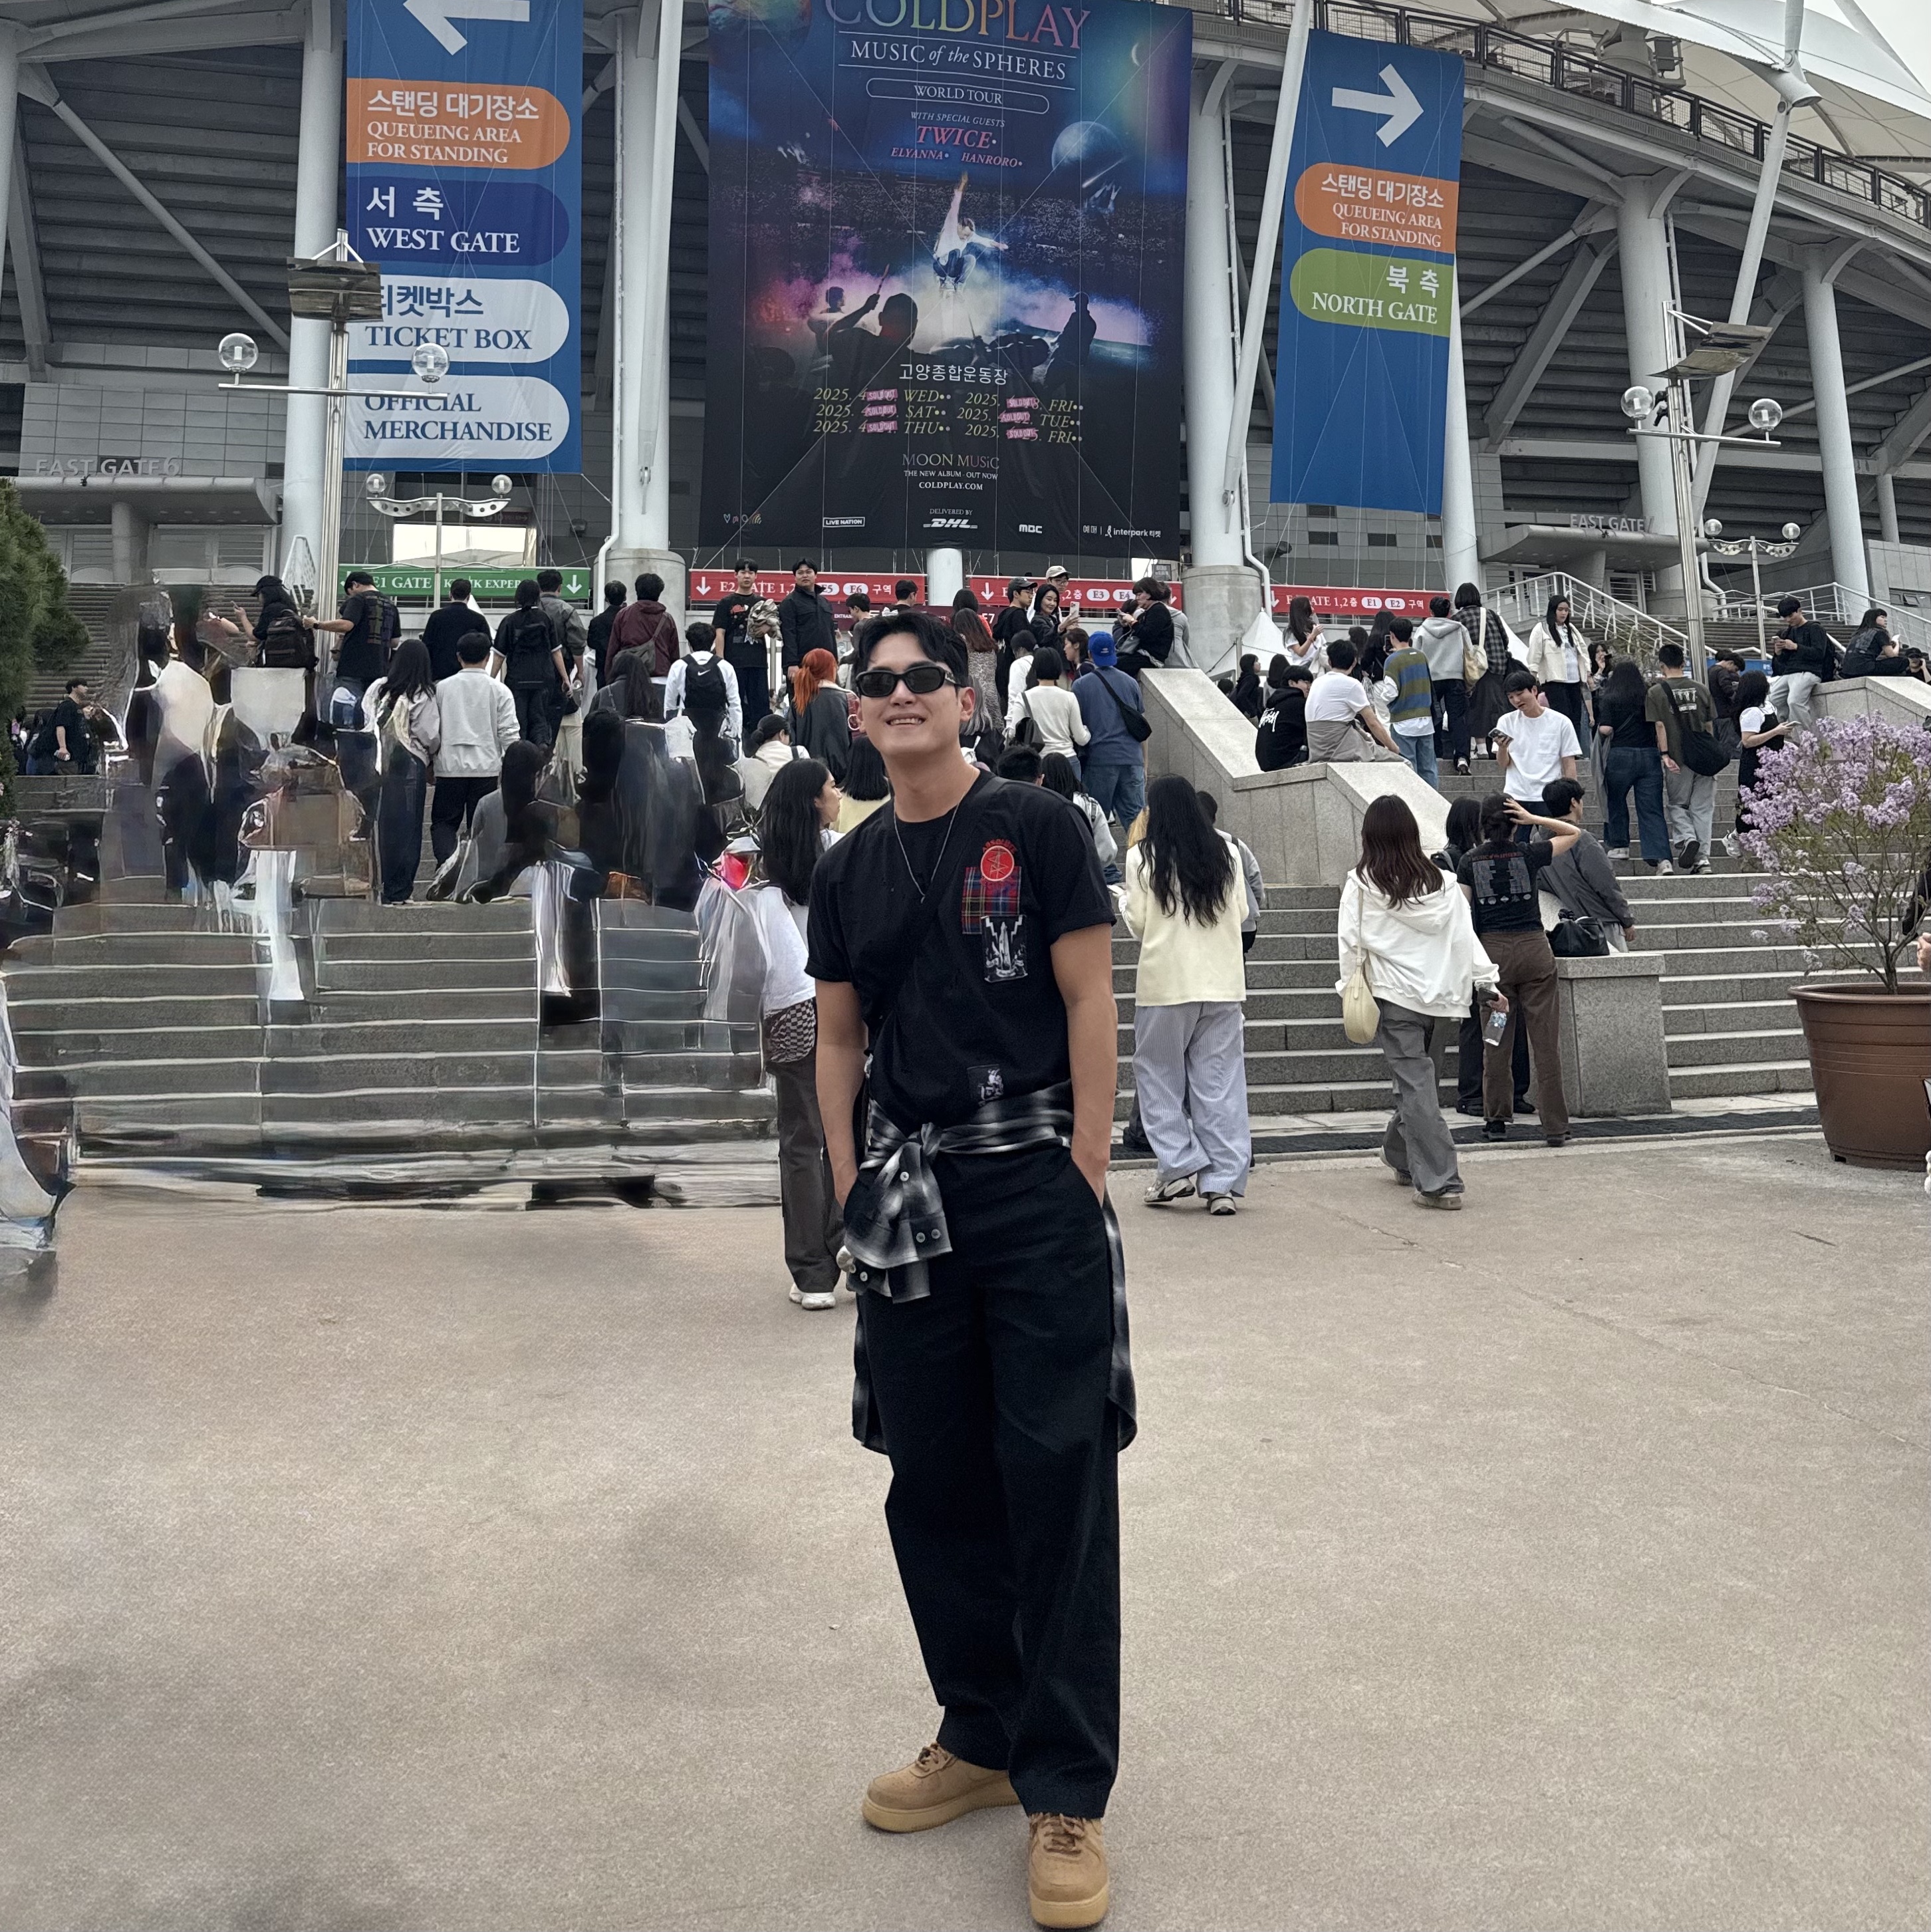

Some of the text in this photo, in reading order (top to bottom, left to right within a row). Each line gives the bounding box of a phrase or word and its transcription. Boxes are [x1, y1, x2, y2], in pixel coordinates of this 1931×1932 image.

[825, 0, 1091, 49] COLDPLAY
[850, 40, 1066, 80] MUSIC of the SPHERES
[914, 84, 1003, 105] WORLD TOUR
[368, 90, 539, 121] 스탠딩 대기장소
[910, 111, 1005, 128] WITH SPECIAL GUESTS
[368, 121, 522, 144] QUEUEING AREA
[917, 126, 992, 149] TWICE
[368, 142, 508, 164] FOR STANDING
[891, 148, 1018, 168] ELYANNA HANRORO
[1321, 173, 1444, 209] 스탠딩 대기장소
[366, 186, 444, 220] 서 측
[1333, 203, 1442, 230] QUEUEING AREA
[366, 227, 520, 253] WEST GATE
[1341, 221, 1441, 248] FOR STANDING
[1386, 265, 1439, 299] 북 측
[1312, 292, 1438, 325] NORTH GATE
[365, 326, 533, 350] TICKET BOX
[899, 363, 1008, 386] 고양종합운동장
[365, 393, 481, 412] OFFICIAL
[814, 388, 852, 401] 2025.
[904, 390, 940, 402] WED
[966, 392, 1000, 406] 2025.
[1049, 400, 1074, 412] FRI
[816, 404, 854, 417] 2025.
[906, 406, 936, 418] SAT
[957, 407, 991, 421] 2025.
[1040, 414, 1071, 428] TUE
[364, 420, 552, 442] MERCHANDISE
[813, 420, 851, 434] 2025.
[904, 422, 940, 434] THU
[965, 424, 999, 438] 2025.
[1048, 431, 1073, 444] FRI
[100, 458, 161, 476] GATE
[902, 454, 953, 466] MOON
[919, 482, 983, 490] COLDPLAY.COM
[931, 518, 971, 529] DHL
[1113, 528, 1148, 537] interpark
[1570, 513, 1604, 529] EAST
[1609, 517, 1644, 532] GATE
[392, 576, 432, 589] GATE
[751, 583, 775, 593] ATE
[872, 585, 892, 595] 구역
[1311, 595, 1332, 606] ATE
[1408, 600, 1424, 610] 구역
